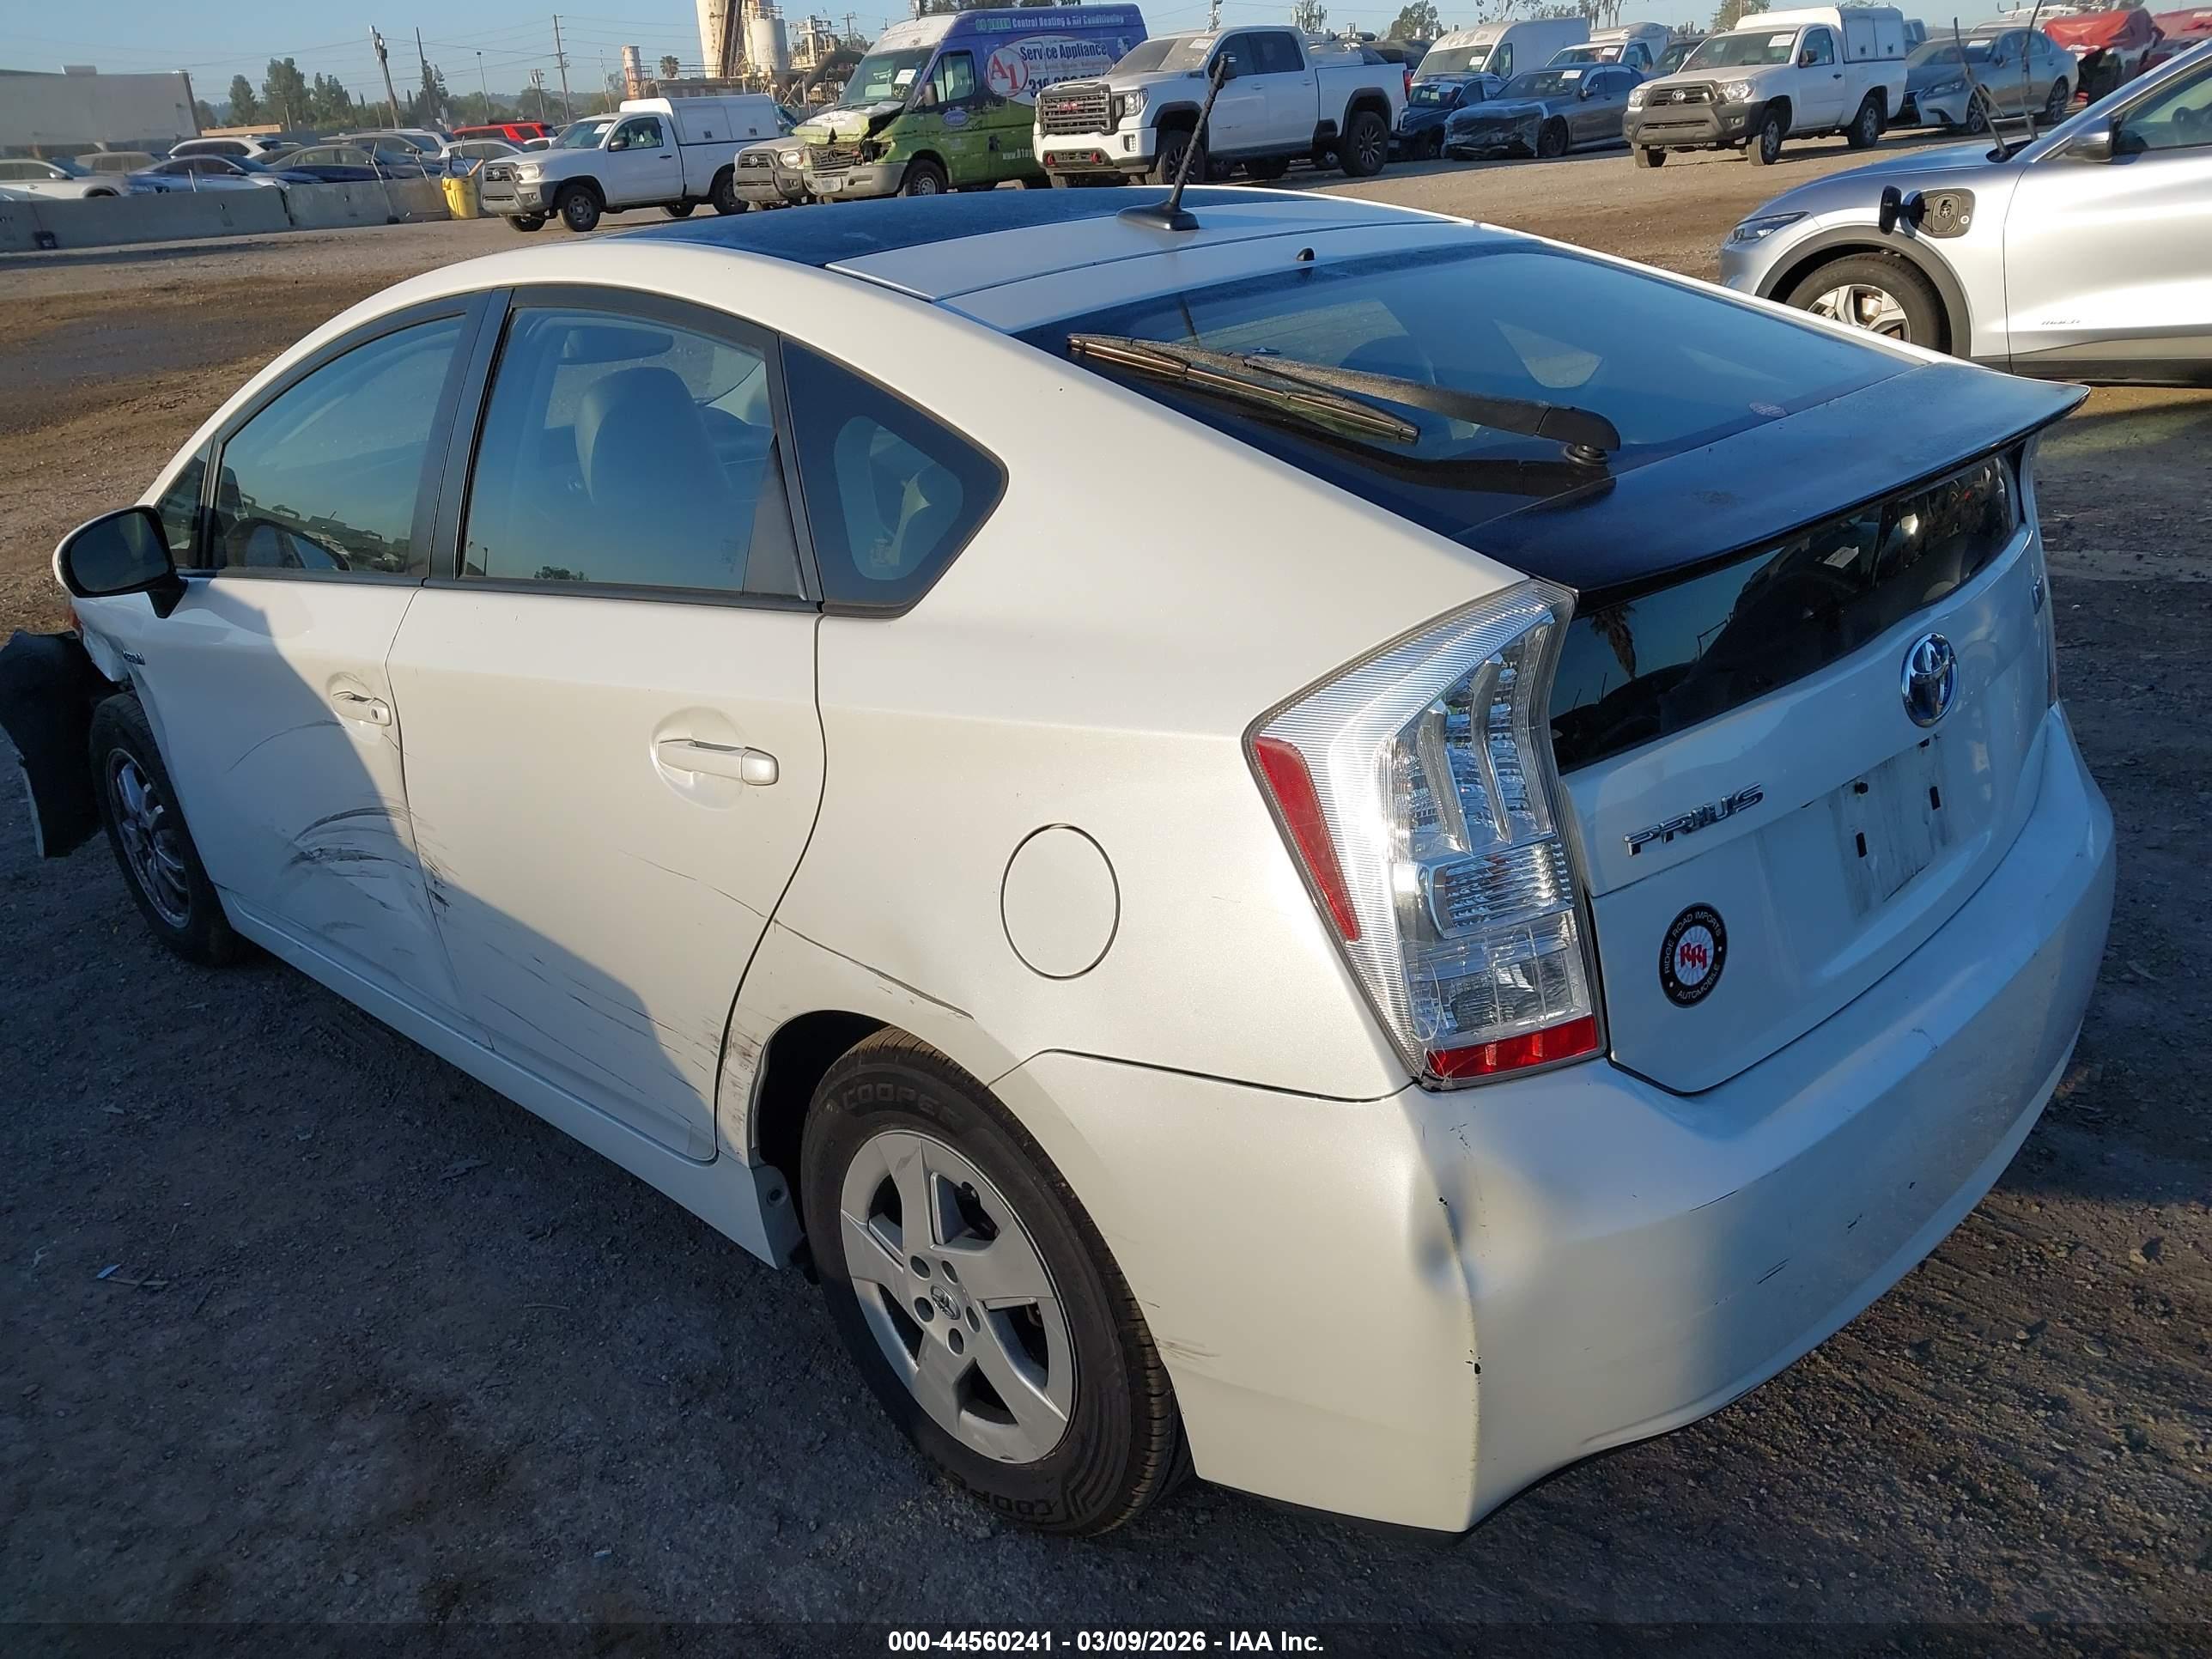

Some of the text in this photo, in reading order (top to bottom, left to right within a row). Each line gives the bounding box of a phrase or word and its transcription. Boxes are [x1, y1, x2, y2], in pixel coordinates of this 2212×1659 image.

[1020, 43, 1107, 61] Servce Appliance
[1623, 782, 1765, 858] PRIUS
[1664, 910, 1723, 974] RIDGE ROAD IMPORTS
[1677, 963, 1720, 1000] AUTOMOBILE
